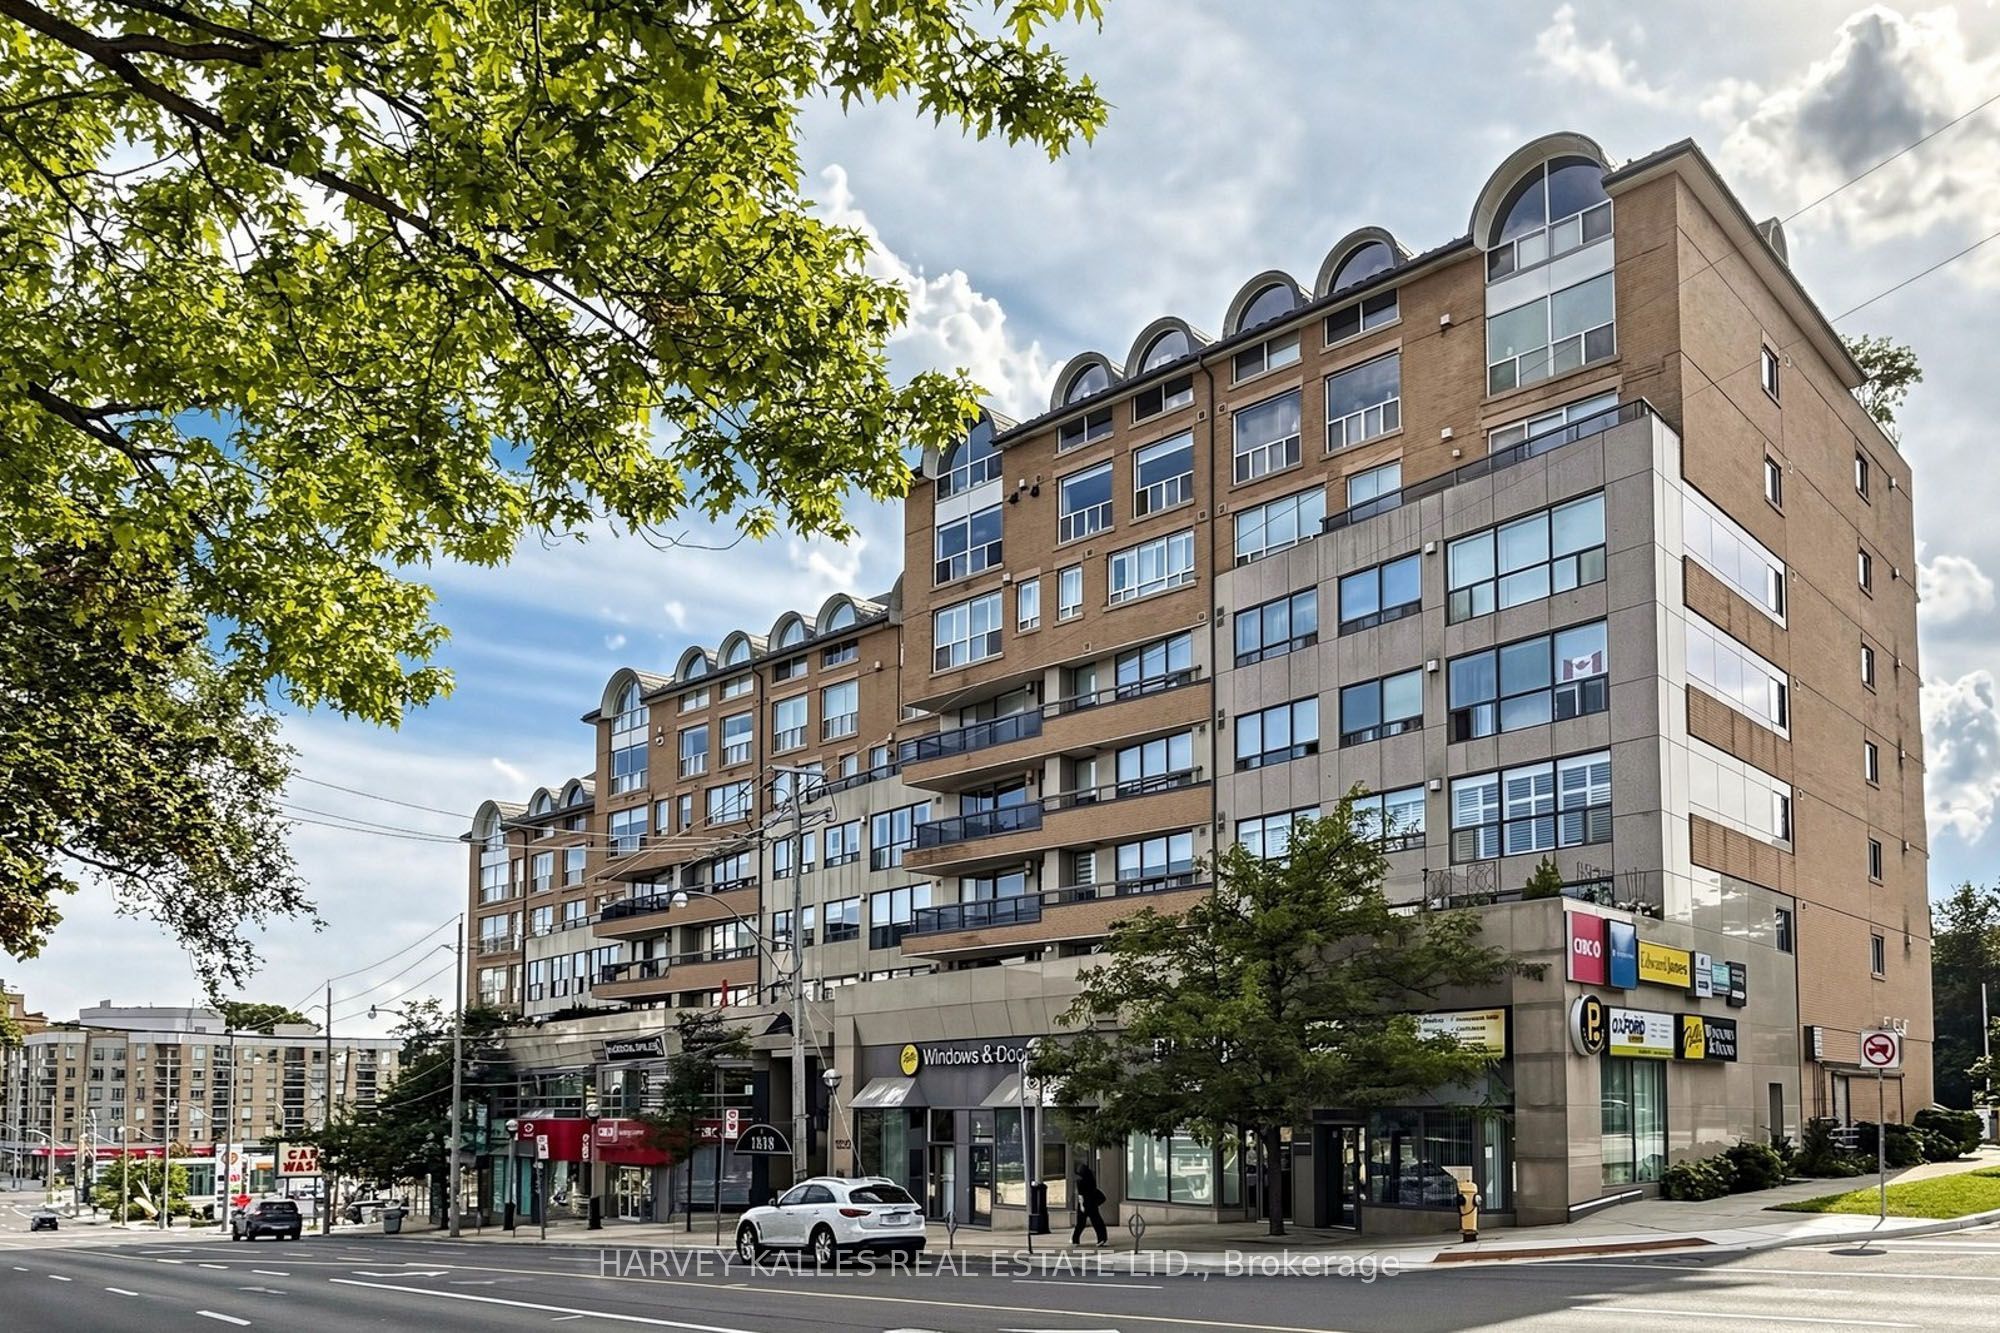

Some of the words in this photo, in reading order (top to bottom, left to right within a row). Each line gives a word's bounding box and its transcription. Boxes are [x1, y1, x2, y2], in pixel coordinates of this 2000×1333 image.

[923, 1049, 979, 1065] Windows
[982, 1044, 993, 1064] &
[995, 1044, 1028, 1064] Doo
[288, 1149, 319, 1160] CAR
